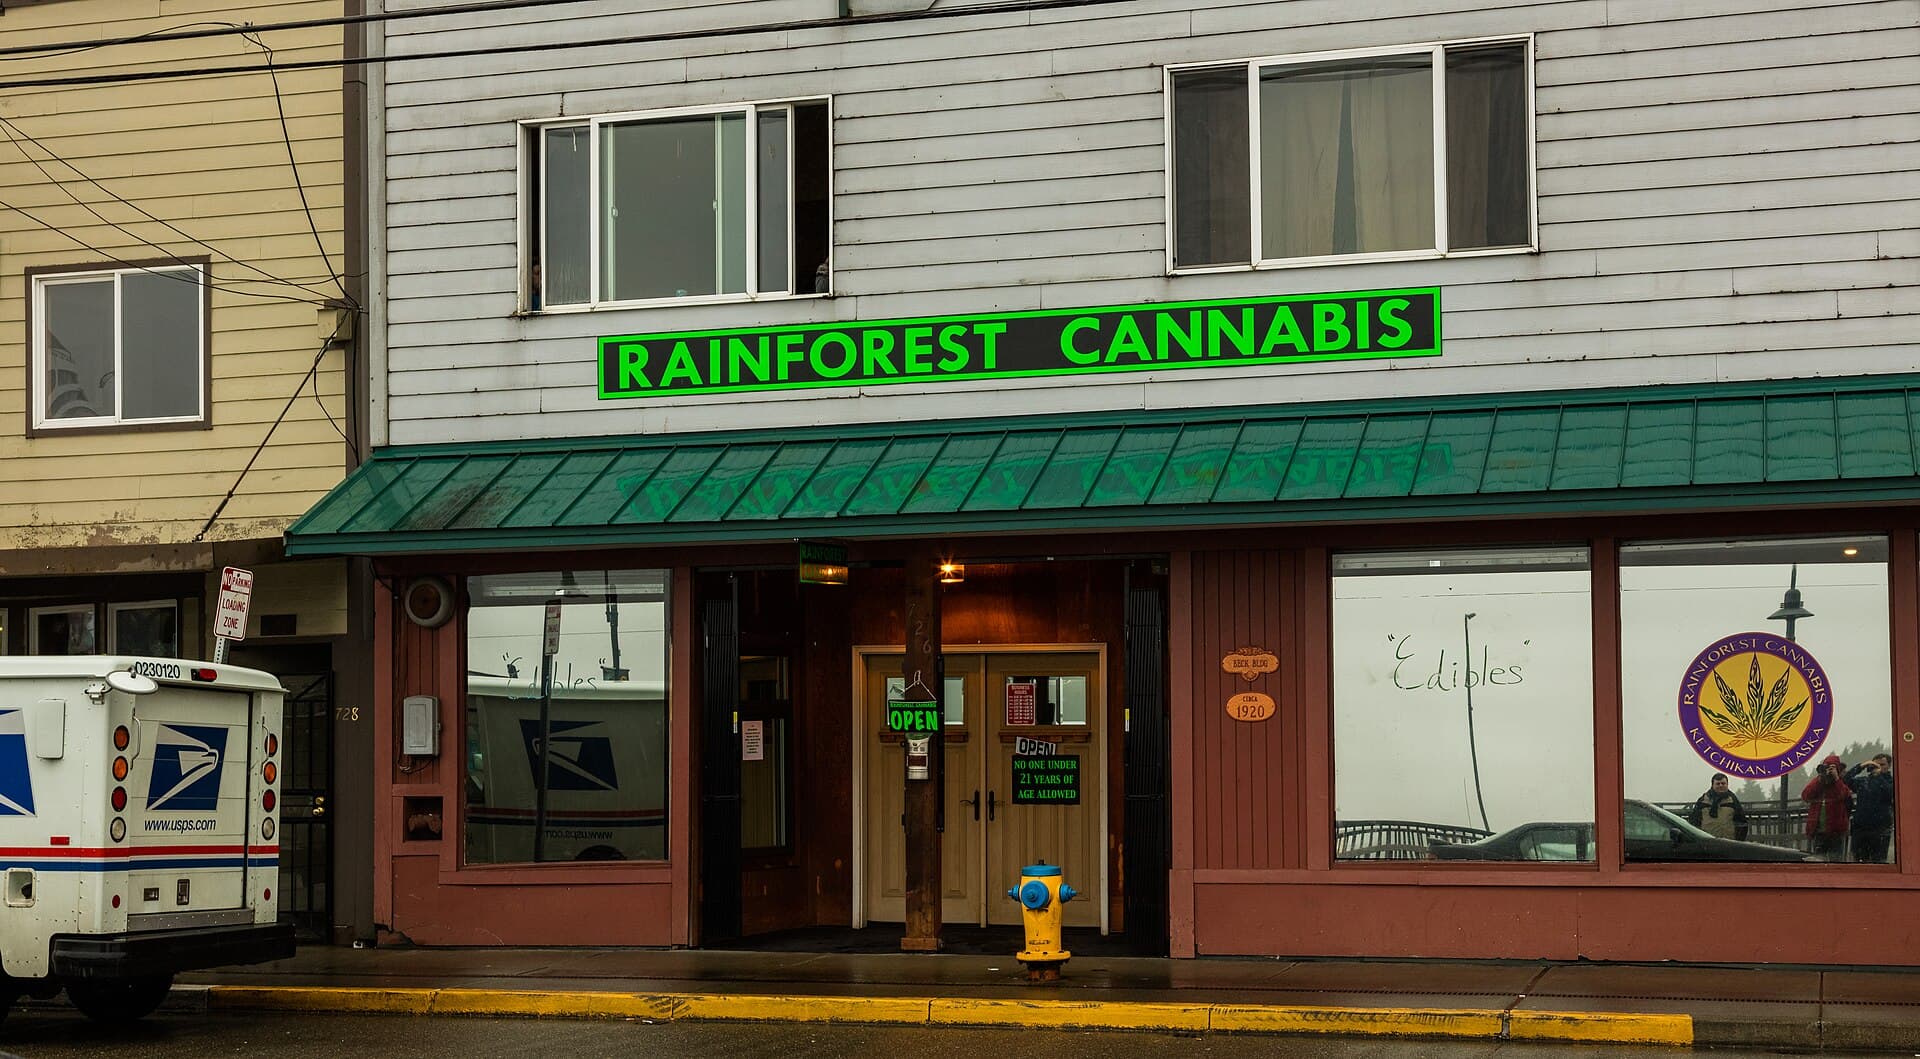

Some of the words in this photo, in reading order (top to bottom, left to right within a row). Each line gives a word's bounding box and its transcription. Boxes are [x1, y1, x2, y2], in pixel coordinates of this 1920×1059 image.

[618, 322, 1007, 389] RAINFOREST
[1060, 298, 1414, 365] CANNABIS
[224, 572, 233, 586] NO
[232, 576, 251, 588] PARKING
[222, 598, 246, 613] LOADING
[223, 616, 239, 629] ZONE
[135, 661, 180, 679] 0230120
[1232, 659, 1249, 668] BECK
[1252, 659, 1268, 668] BLDG
[1684, 638, 1757, 705] RAINFOREST
[1765, 639, 1827, 704] CANNABIS
[336, 707, 359, 721] 728
[1237, 705, 1265, 718] 1920
[890, 710, 938, 731] OPEN
[1019, 738, 1054, 755] OPEN
[1780, 727, 1825, 770] ALASKA
[1014, 760, 1026, 769] NO
[1028, 760, 1046, 769] ONE
[1048, 760, 1077, 769] UNDER
[1020, 772, 1031, 784] 21
[1034, 774, 1061, 784] YEARS
[1063, 774, 1073, 784] OF
[1018, 789, 1035, 798] AGE
[1036, 789, 1076, 798] ALLOWED
[144, 819, 217, 834] www.usps.com
